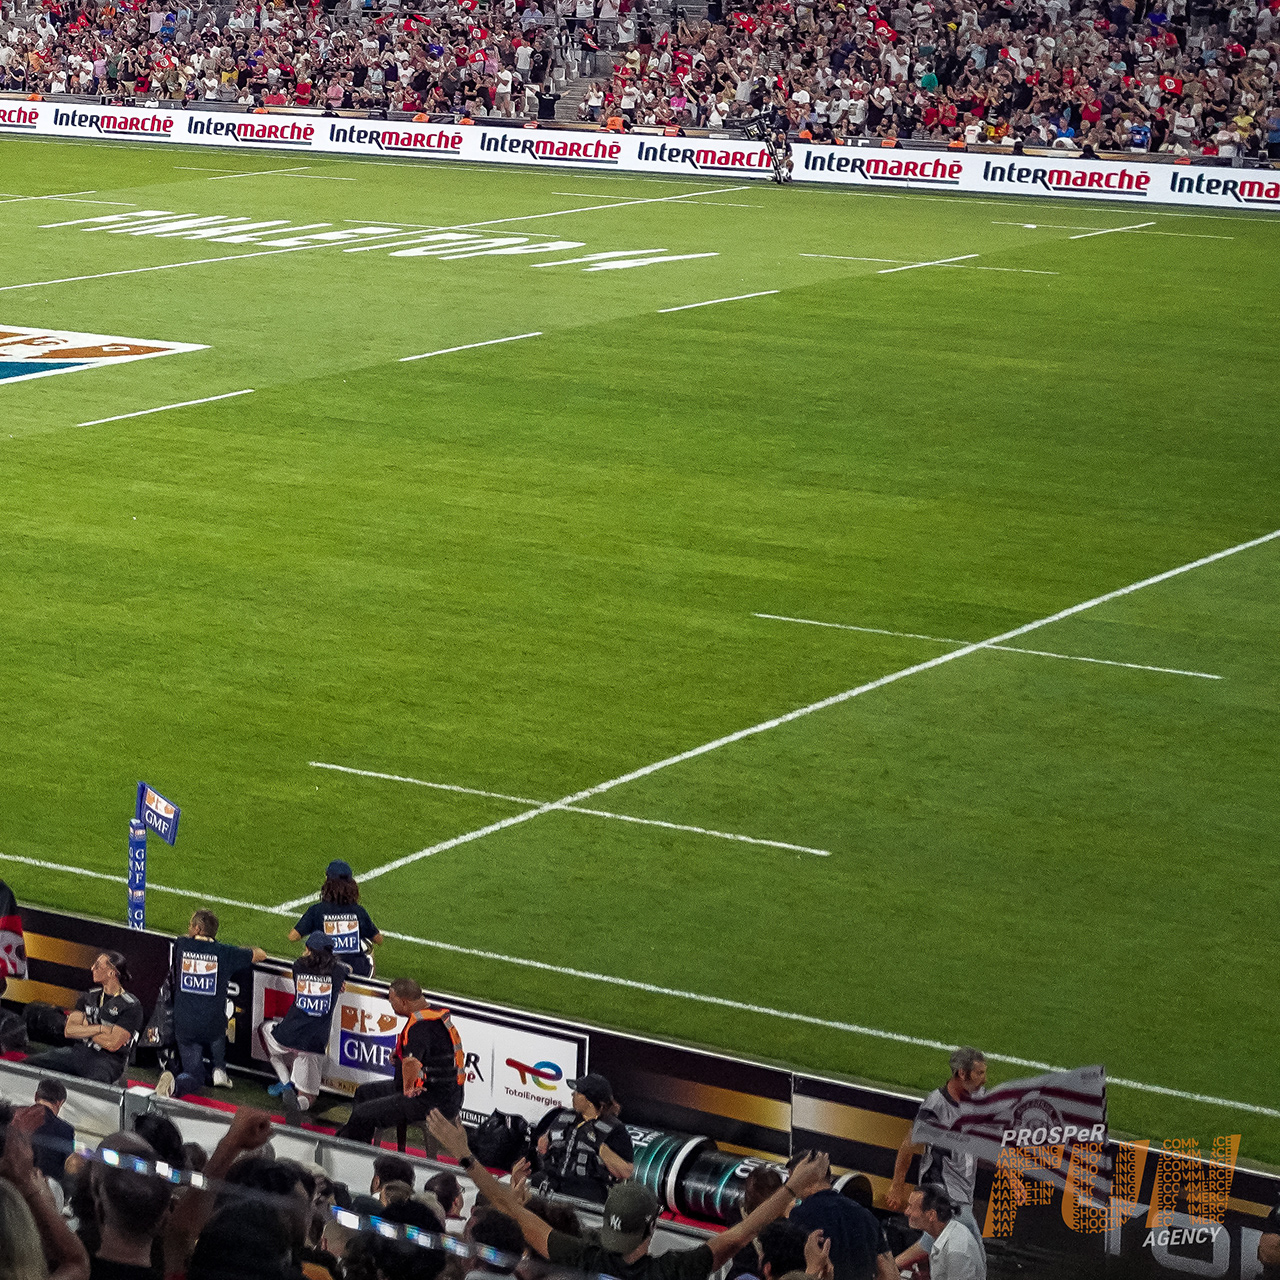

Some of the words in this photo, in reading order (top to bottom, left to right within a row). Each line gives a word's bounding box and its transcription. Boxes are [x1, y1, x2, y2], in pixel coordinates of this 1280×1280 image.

[638, 141, 773, 169] Intermarch
[145, 810, 170, 835] GMF
[182, 951, 218, 962] RAMASSEUR
[184, 975, 214, 990] GMF
[297, 975, 332, 984] RAMASSEUR
[298, 997, 329, 1011] GMF
[344, 1038, 392, 1067] GMF
[504, 1086, 563, 1108] TotalEnergies
